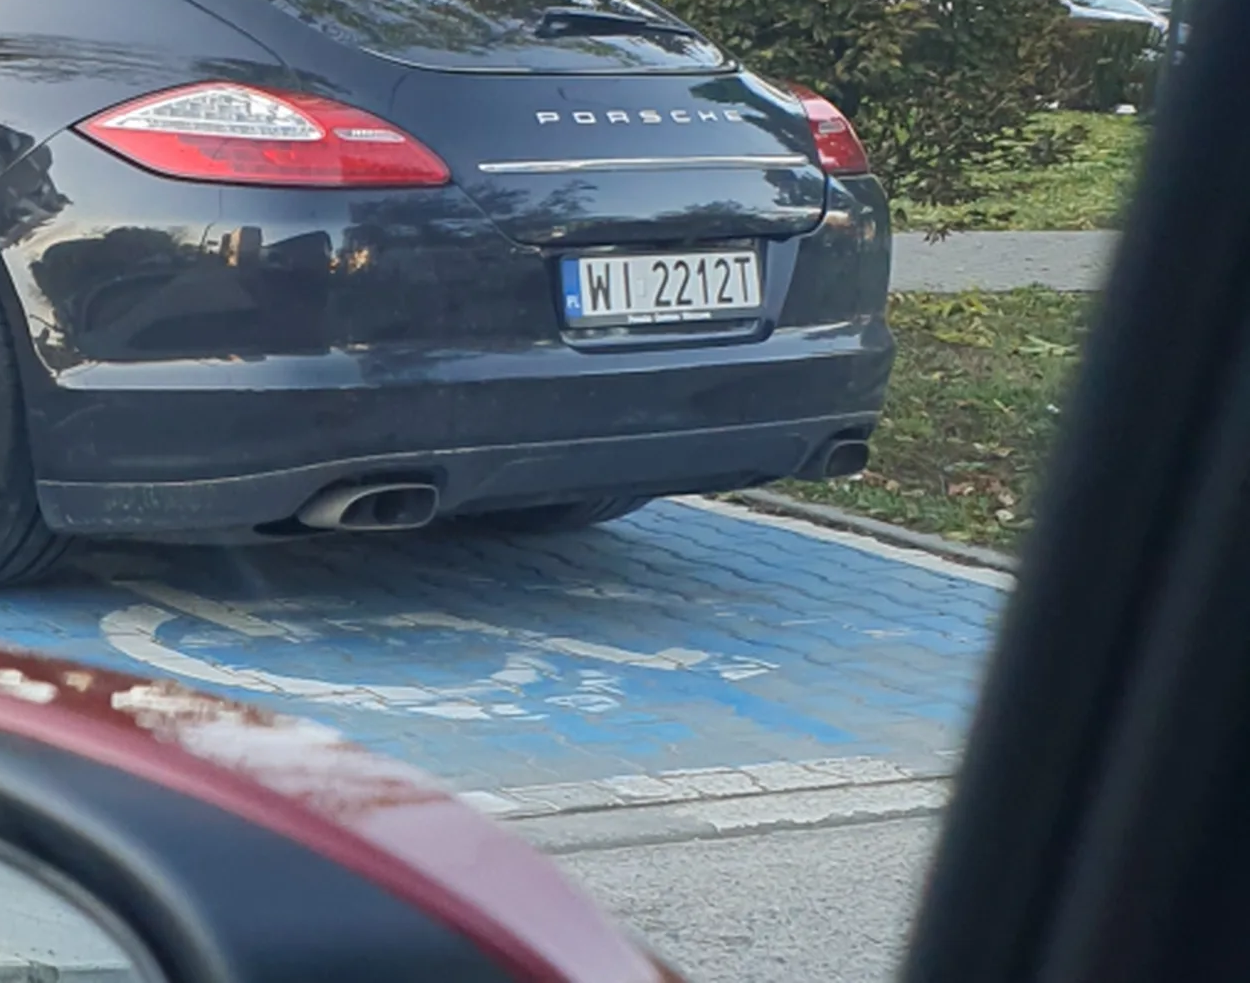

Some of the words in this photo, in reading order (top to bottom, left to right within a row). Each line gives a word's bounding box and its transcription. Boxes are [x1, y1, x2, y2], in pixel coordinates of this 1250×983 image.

[536, 110, 744, 125] PORSCHE
[587, 261, 632, 311] WI
[652, 257, 751, 307] 2212T
